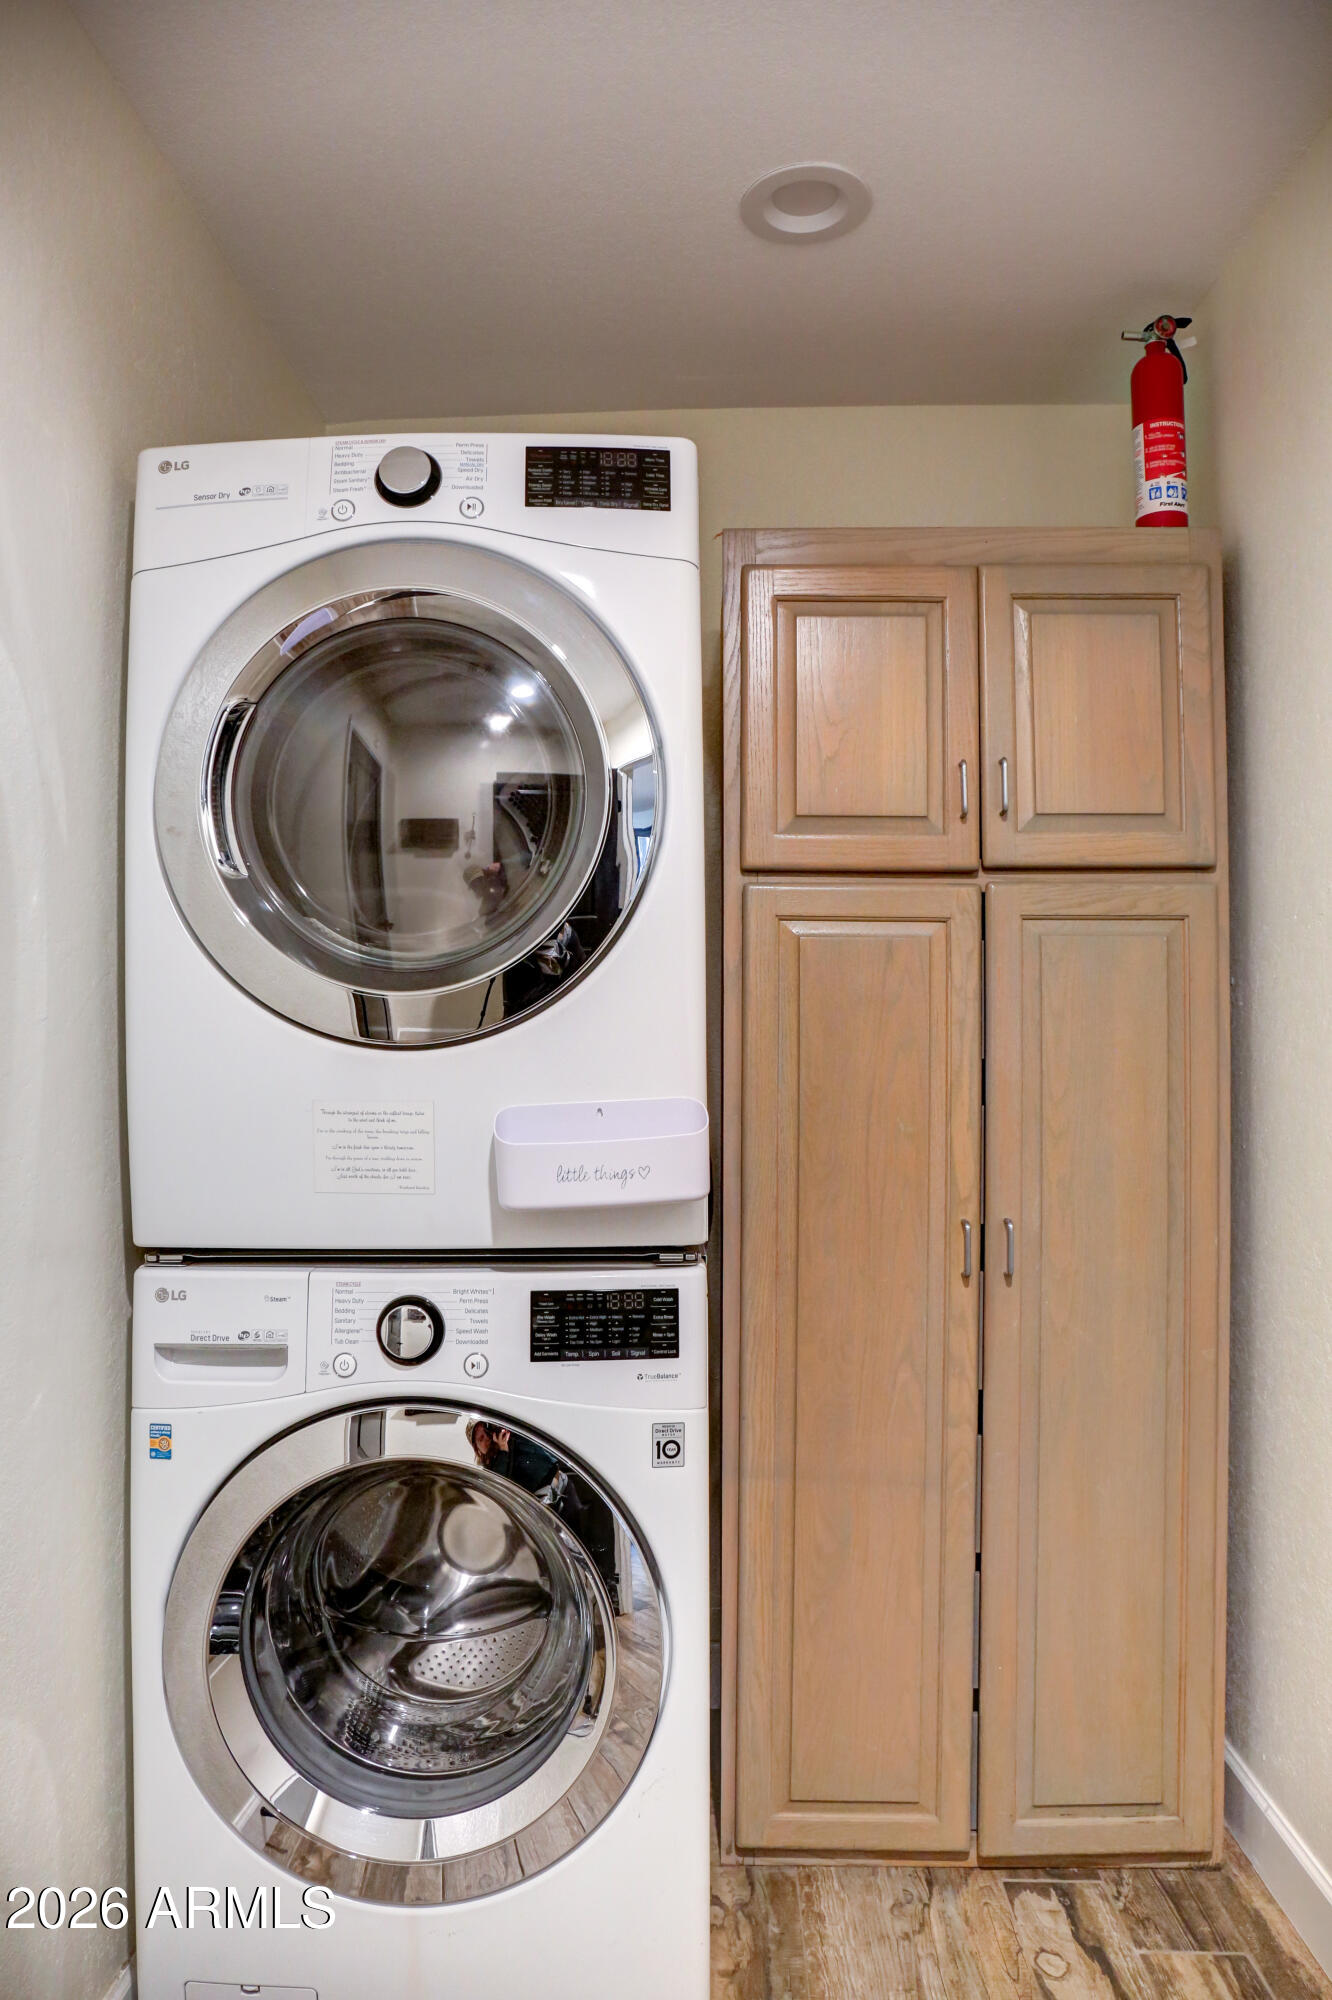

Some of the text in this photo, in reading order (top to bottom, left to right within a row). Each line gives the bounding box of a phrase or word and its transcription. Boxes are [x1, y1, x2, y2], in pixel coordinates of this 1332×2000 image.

[219, 492, 231, 500] Dry
[556, 1164, 635, 1189] little things
[190, 1334, 230, 1342] Direct Drive
[656, 1440, 681, 1460] 10
